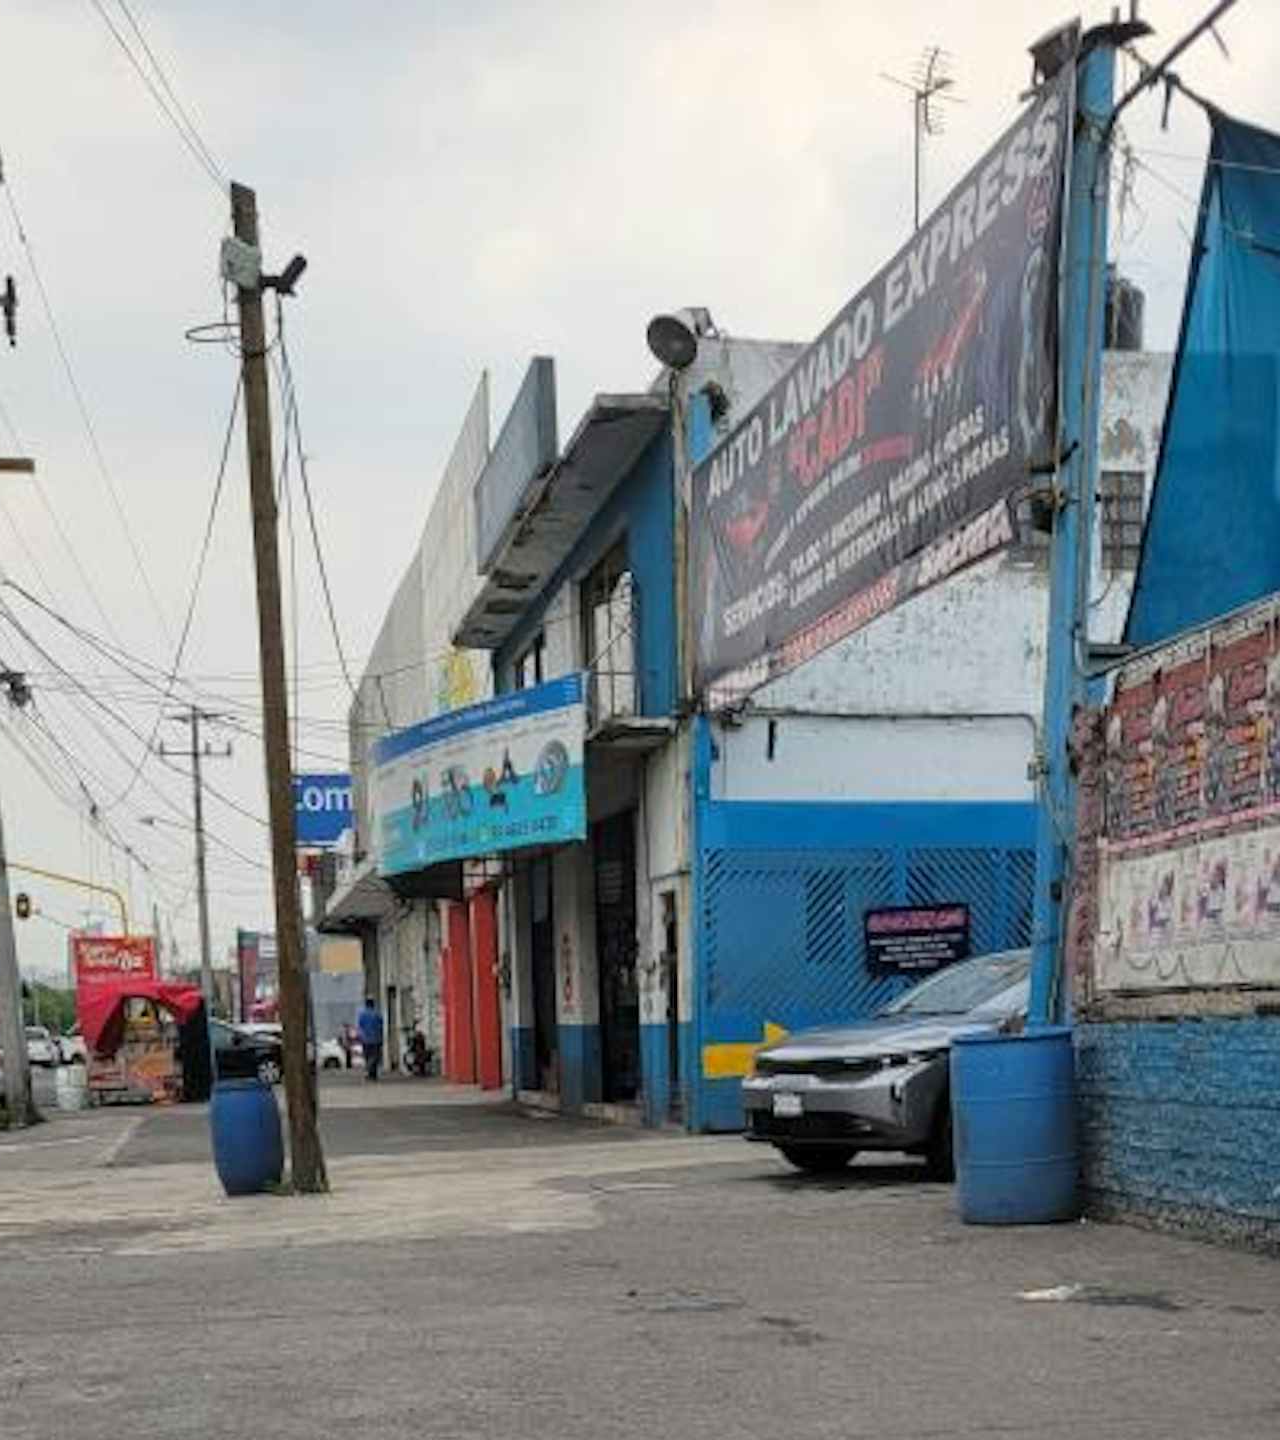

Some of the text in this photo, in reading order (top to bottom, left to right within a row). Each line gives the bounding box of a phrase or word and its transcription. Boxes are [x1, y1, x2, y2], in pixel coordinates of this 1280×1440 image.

[707, 418, 763, 498] AUTO
[769, 300, 874, 446] LAVADO
[882, 97, 1059, 333] EXPRESS
